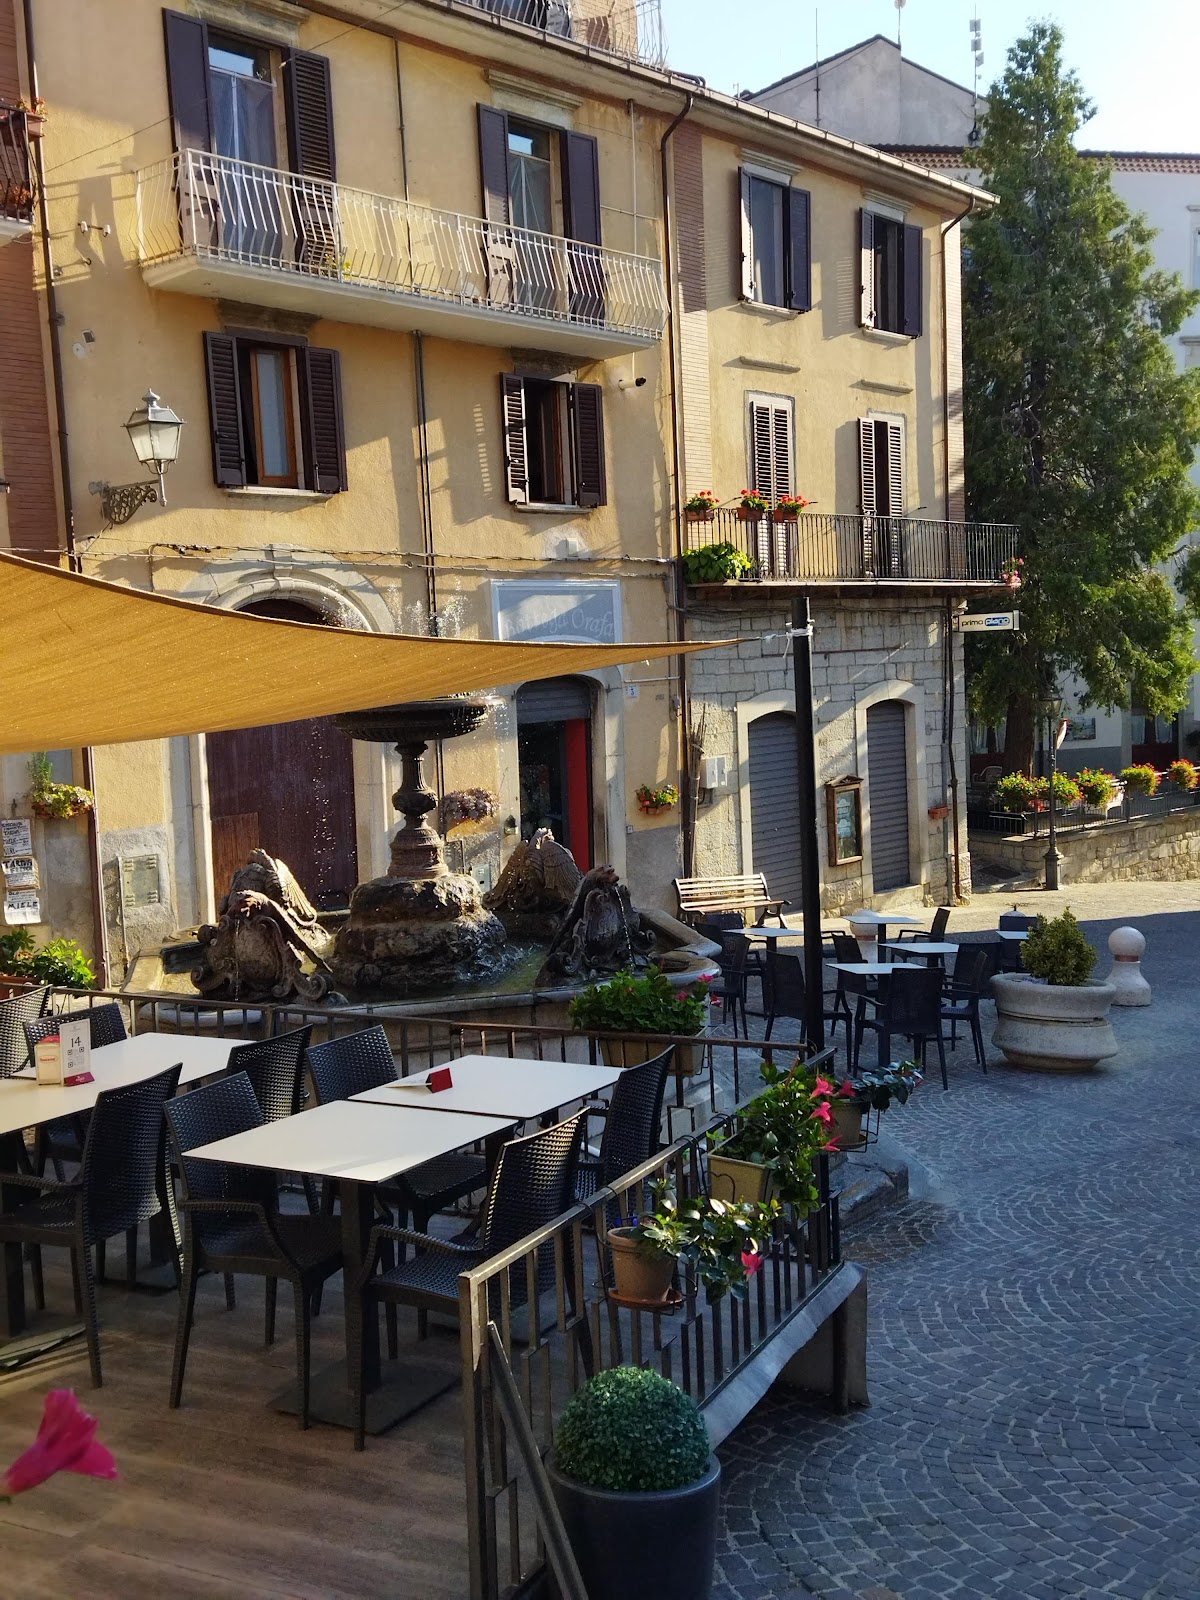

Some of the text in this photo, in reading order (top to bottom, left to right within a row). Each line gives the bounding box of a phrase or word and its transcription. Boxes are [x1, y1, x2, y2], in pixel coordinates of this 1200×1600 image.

[571, 608, 614, 637] Orafa
[961, 619, 984, 627] prima
[8, 901, 39, 910] MIELE
[70, 1036, 81, 1048] 14
